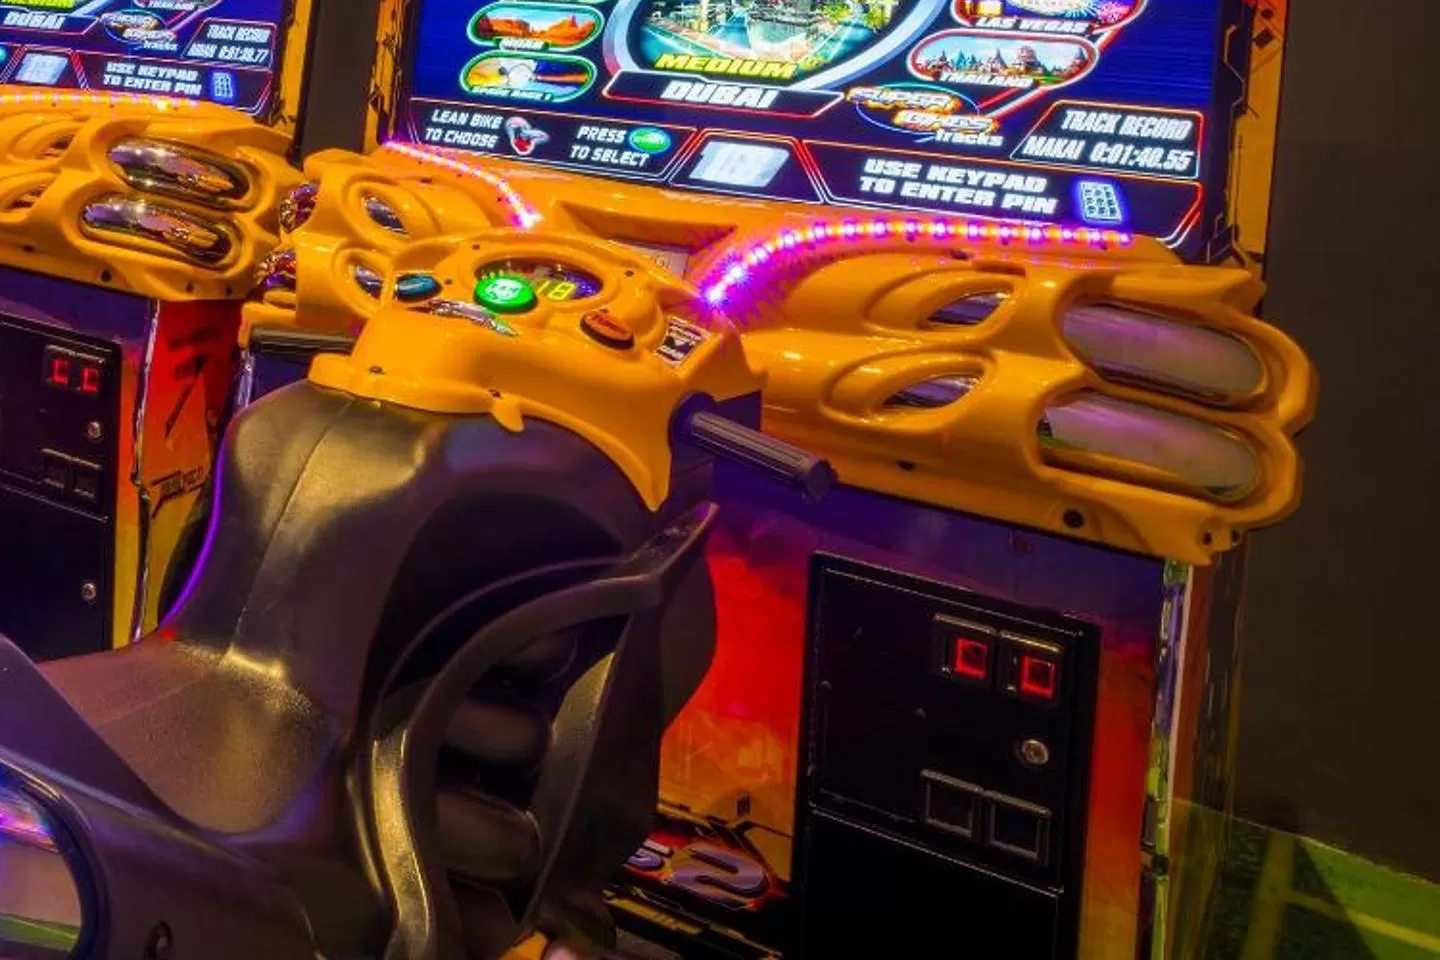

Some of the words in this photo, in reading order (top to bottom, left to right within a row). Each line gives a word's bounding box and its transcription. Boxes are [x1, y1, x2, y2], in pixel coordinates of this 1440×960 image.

[975, 16, 1015, 30] LAS
[1017, 18, 1091, 35] VEGAS
[654, 53, 799, 80] MEDIUM
[660, 80, 780, 110] DUBAI
[847, 87, 956, 110] SUPER
[431, 108, 469, 126] LEAN
[470, 112, 503, 130] BIKE
[1060, 109, 1120, 134] TRACK
[1121, 115, 1194, 141] RECORD
[425, 126, 442, 142] TO
[443, 128, 499, 150] CHOOSE
[576, 125, 627, 144] PRESS
[570, 144, 591, 160] TO
[591, 147, 650, 168] SELECT
[863, 158, 923, 178] USE
[926, 163, 1048, 192] KEYPAD
[860, 176, 896, 195] TO
[900, 181, 998, 207] ENTER
[1001, 192, 1059, 215] PIN
